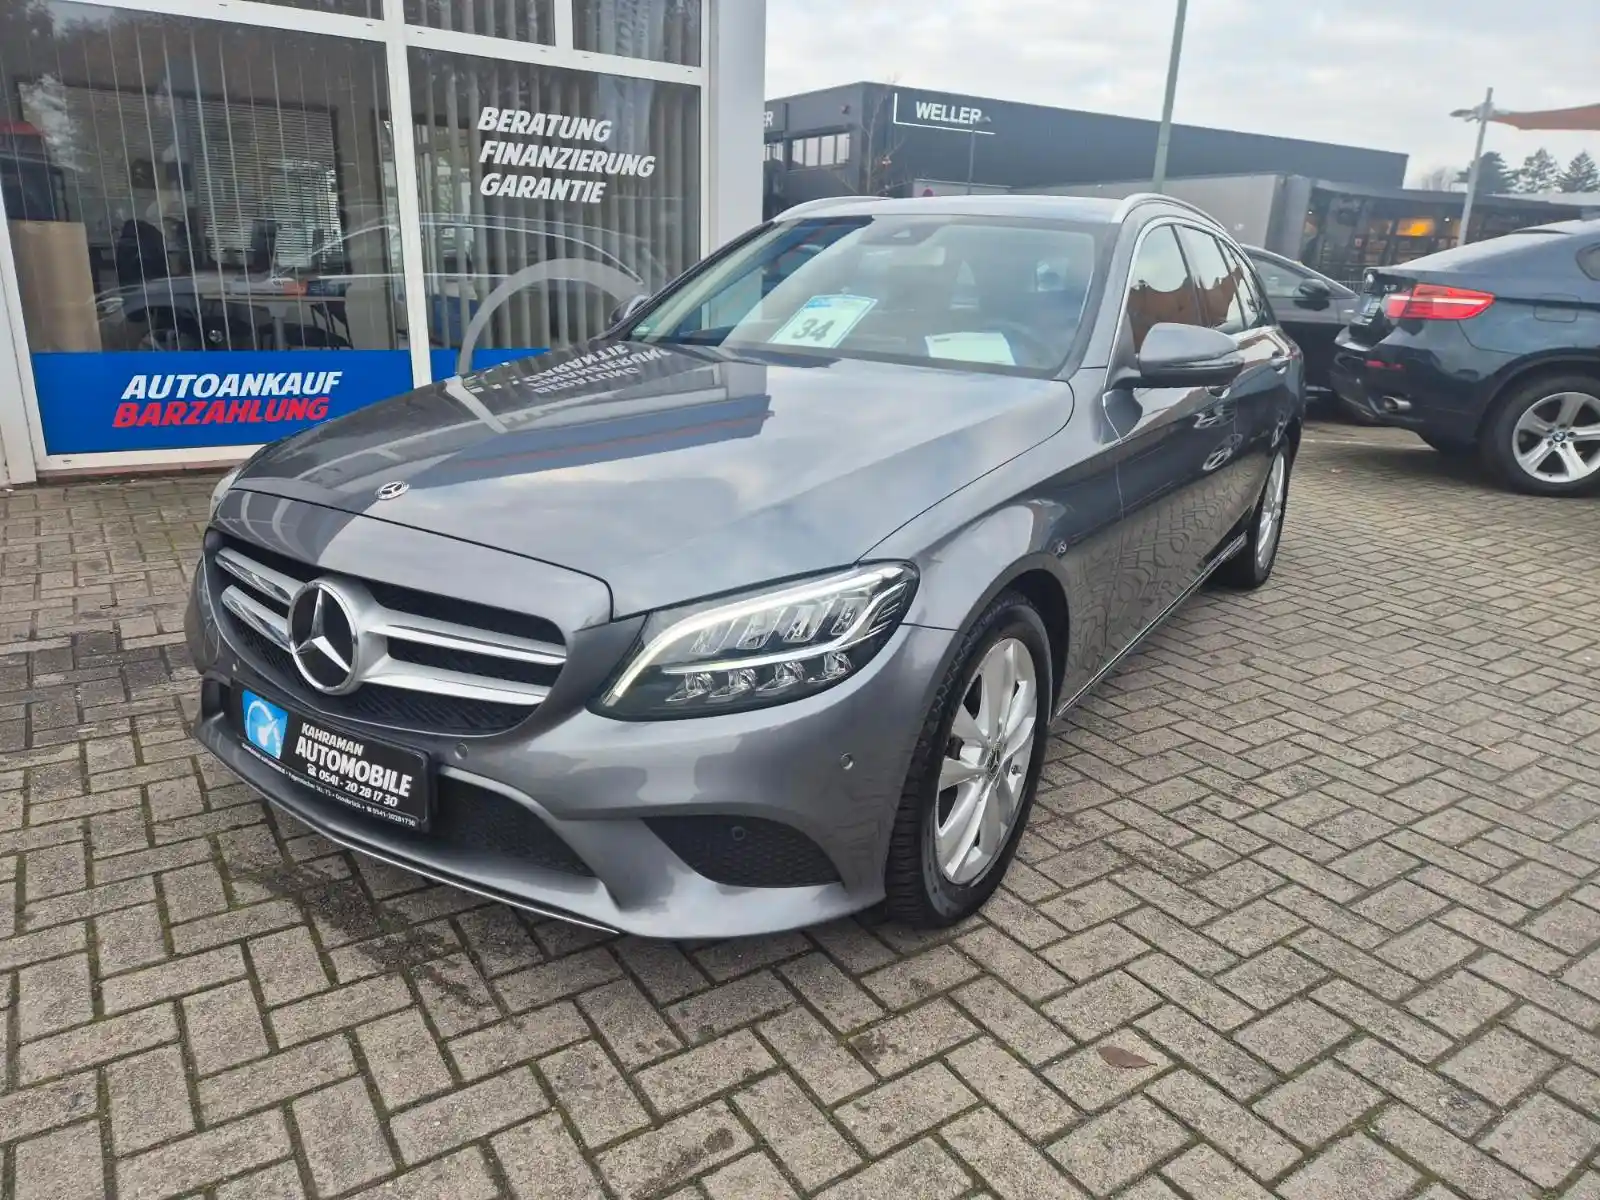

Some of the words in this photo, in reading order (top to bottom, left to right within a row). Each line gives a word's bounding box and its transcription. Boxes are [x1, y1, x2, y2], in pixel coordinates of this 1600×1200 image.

[477, 106, 612, 142] BERATUNG
[916, 101, 982, 124] WELLER
[478, 140, 656, 178] FINANZIERUNG
[479, 173, 607, 203] GARANTIE
[791, 318, 835, 342] 34
[121, 371, 343, 400] AUTOANKAUF
[112, 397, 330, 428] BARZAHLUNG
[301, 722, 364, 756] KAHRAMAN
[295, 735, 413, 798] AUTOMOBILE
[319, 769, 339, 786] 0541
[345, 780, 358, 794] 20
[359, 785, 372, 798] 28
[373, 790, 383, 802] 17
[383, 794, 398, 807] 30
